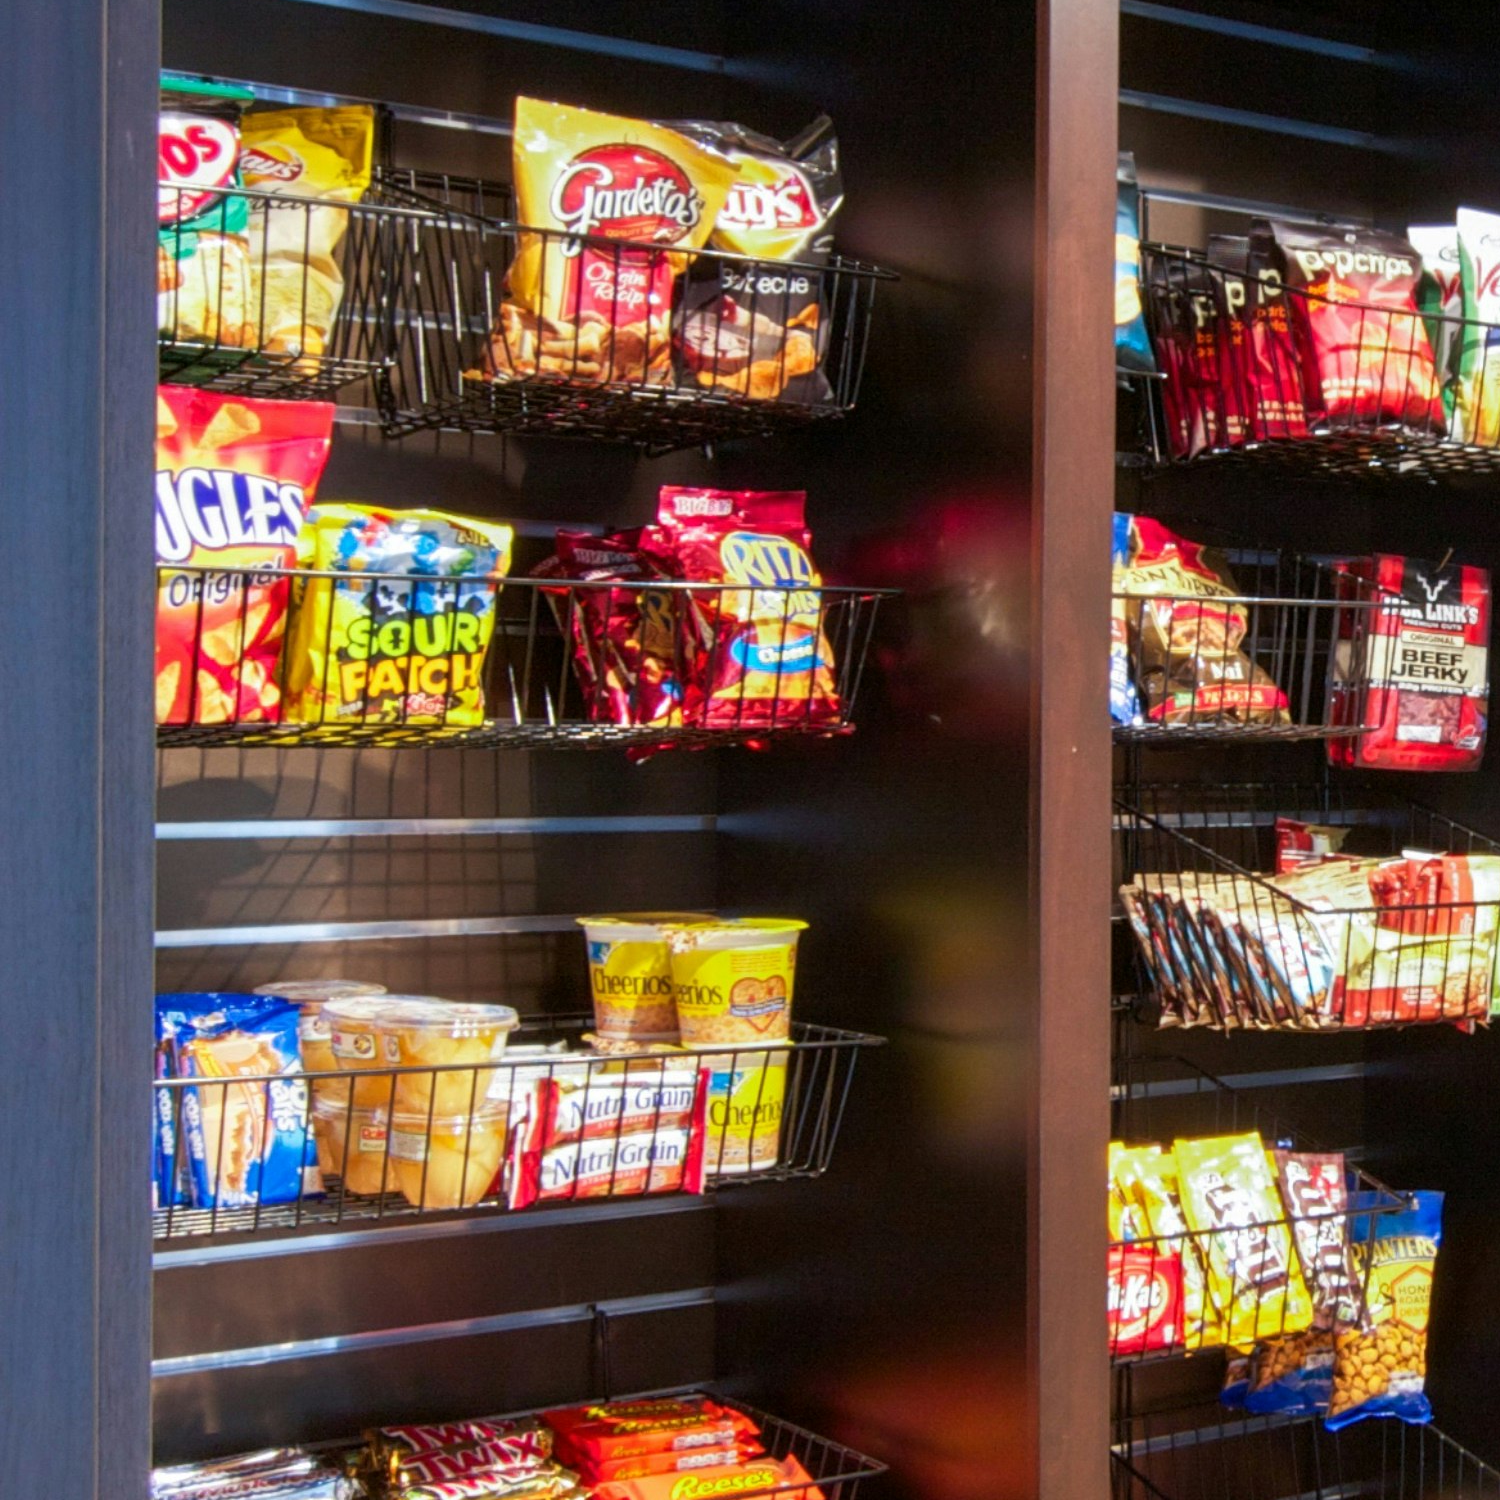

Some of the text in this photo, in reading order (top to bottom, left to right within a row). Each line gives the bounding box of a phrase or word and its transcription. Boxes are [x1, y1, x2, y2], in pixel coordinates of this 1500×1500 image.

[551, 162, 704, 257] Gardetto's
[1425, 602, 1479, 625] LINK'S
[347, 612, 481, 660] SOUR
[1410, 633, 1456, 646] ORIGINAL
[1402, 649, 1463, 666] BEEF
[339, 654, 482, 703] PATCH
[594, 967, 672, 997] Cheerios
[553, 1141, 679, 1186] Nutri Grain
[401, 1431, 546, 1482] TWIX
[669, 1471, 774, 1500] Reese's
